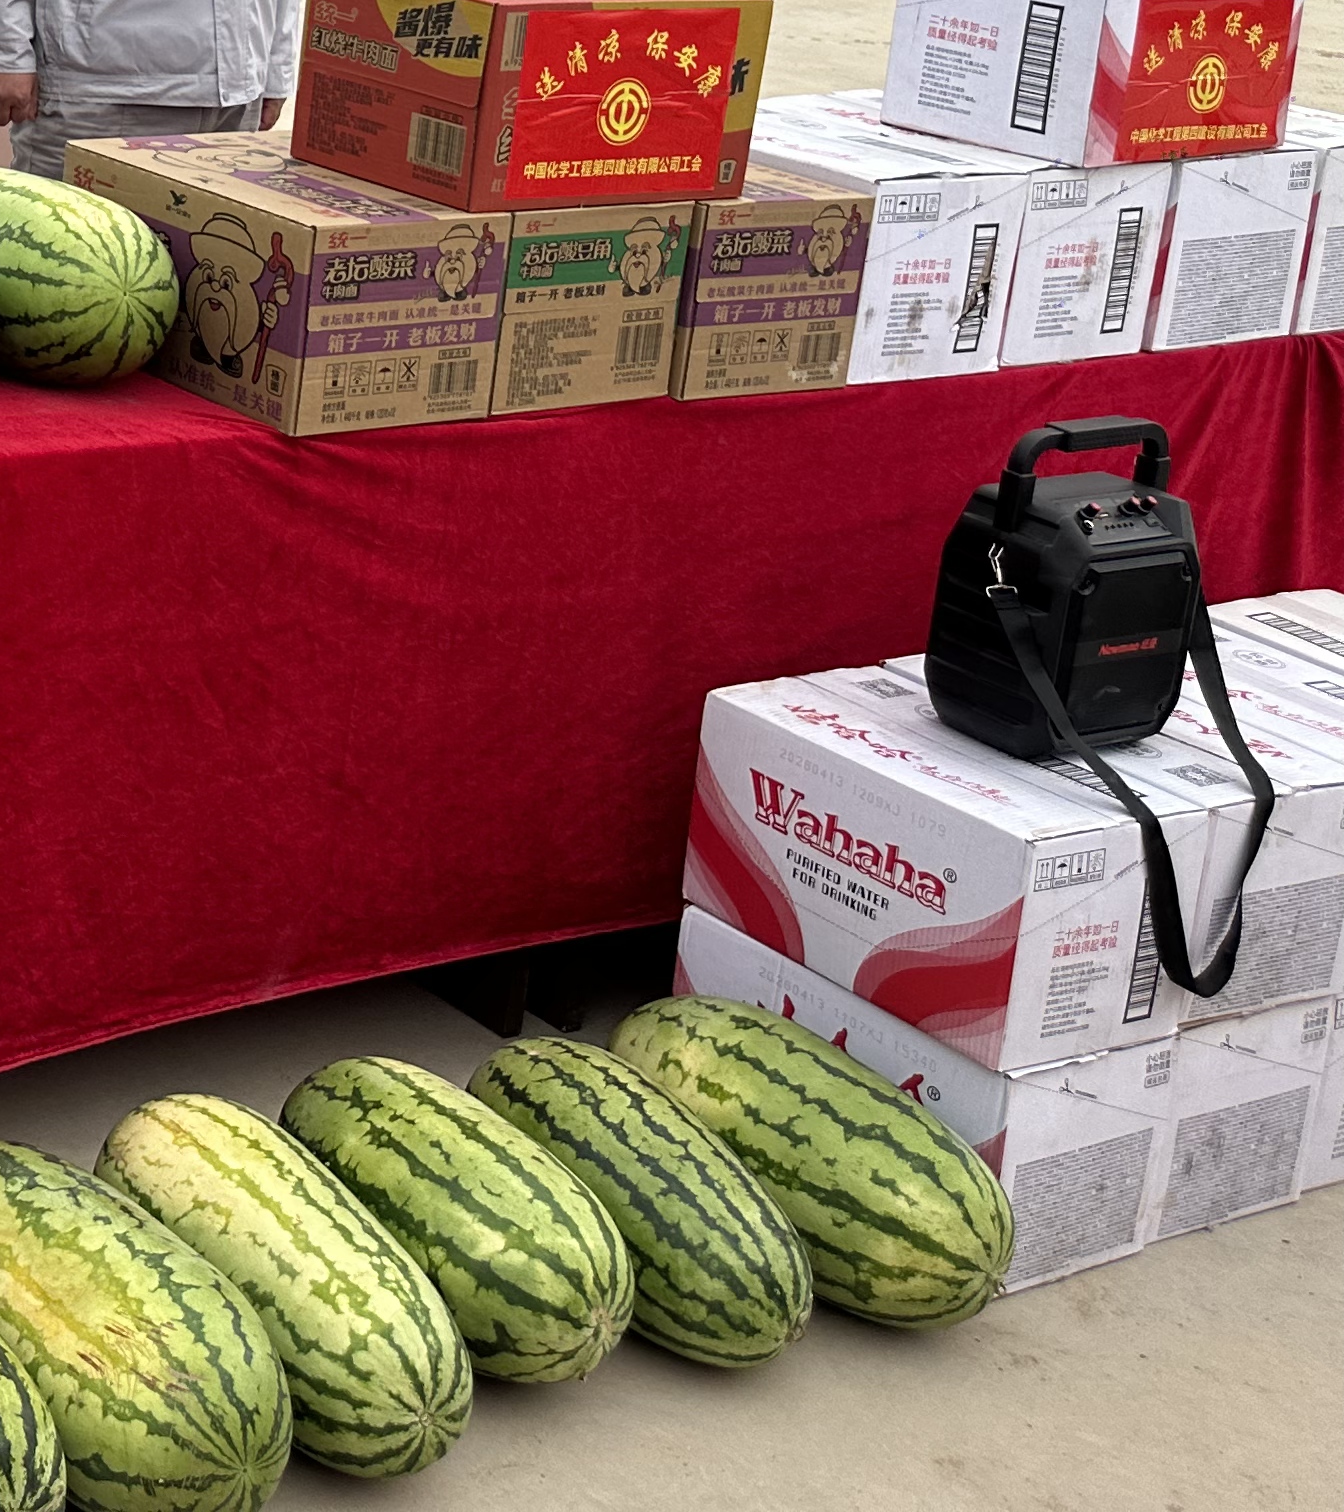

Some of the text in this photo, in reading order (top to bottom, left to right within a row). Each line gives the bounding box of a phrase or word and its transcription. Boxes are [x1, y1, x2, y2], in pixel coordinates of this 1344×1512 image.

[314, 2, 354, 24] 统一
[394, 1, 456, 40] 酱爆
[311, 25, 399, 72] 红烧牛肉面
[412, 34, 483, 60] 更有味
[1143, 9, 1282, 75] 送清凉 保安康
[535, 29, 723, 100] 送清凉 保安康
[523, 155, 703, 180] 中国化学工程第四建设有限公司工会
[525, 220, 554, 234] 统一
[718, 208, 753, 226] 统一
[328, 231, 367, 249] 统一
[520, 238, 612, 266] 老坛酸豆角
[712, 229, 792, 259] 老坛酸菜
[324, 252, 416, 285] 老坛酸菜
[520, 263, 553, 280] 牛肉面
[710, 258, 742, 274] 牛肉面
[322, 284, 359, 301] 牛肉面
[515, 284, 606, 303] 箱子一开 老板发财
[320, 309, 399, 327] 老坛酸菜牛肉面
[713, 299, 842, 324] 箱子一开 老板发财
[327, 322, 477, 354] 箱子一开 老板发财
[749, 767, 946, 916] Wahaha
[786, 848, 890, 911] PURIFIED WATER
[792, 867, 878, 921] FOR DRINKING
